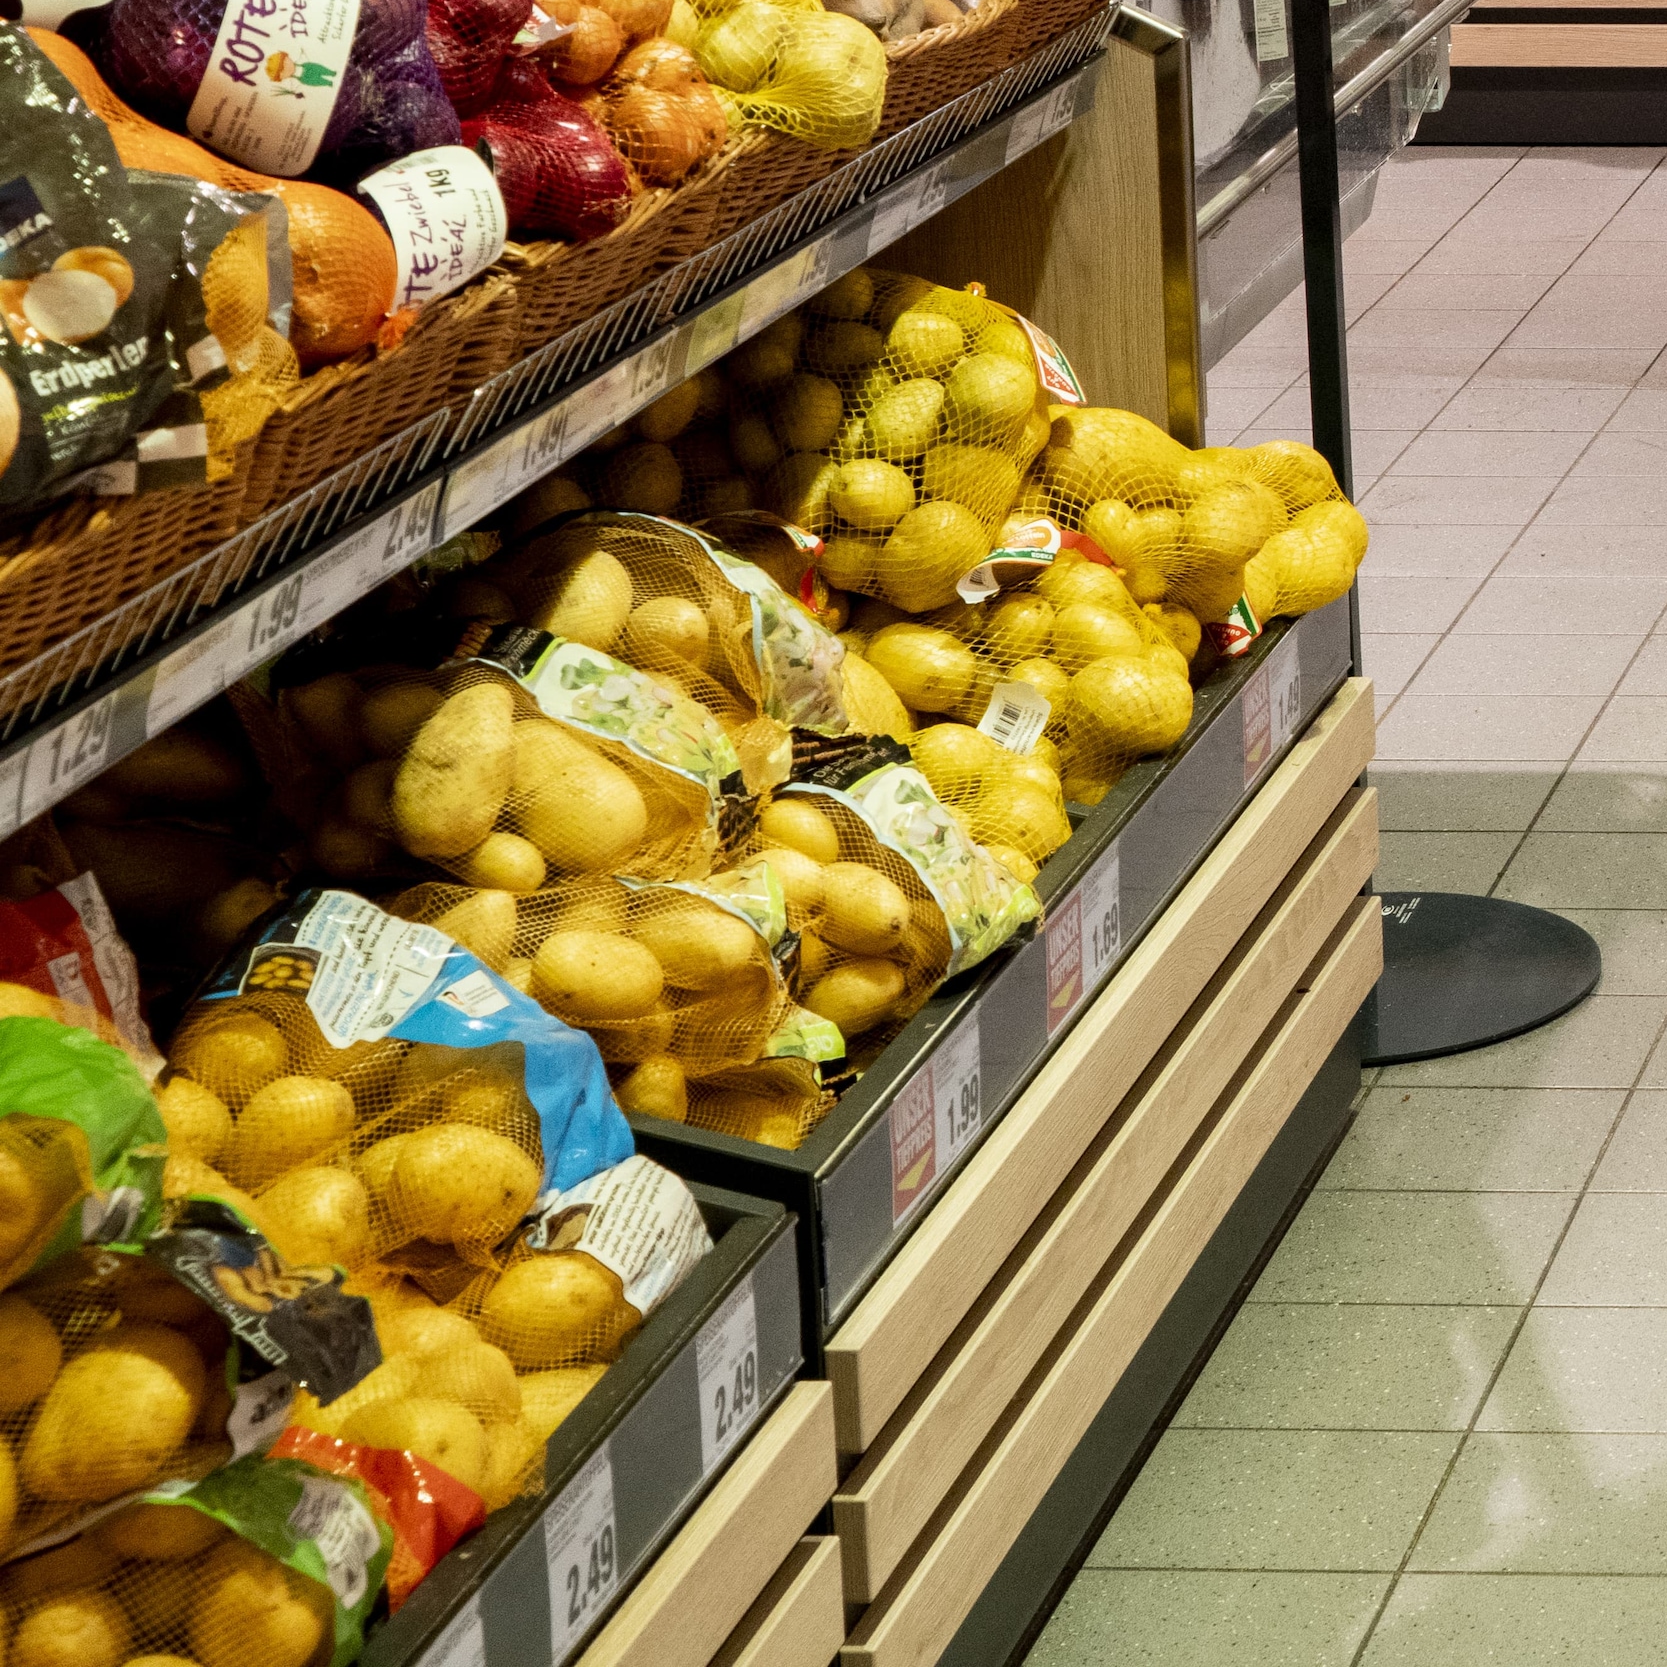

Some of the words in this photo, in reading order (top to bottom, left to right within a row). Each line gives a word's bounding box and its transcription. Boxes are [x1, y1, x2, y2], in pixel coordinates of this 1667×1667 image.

[520, 409, 567, 472] 1.49
[381, 493, 433, 555] 2.49
[245, 576, 303, 646] 1.99
[1277, 676, 1300, 731] 1.49
[49, 699, 111, 784] 1.29
[1091, 902, 1119, 968] 1.69
[947, 1075, 979, 1133] 1.99
[715, 1352, 755, 1441] 2.49
[568, 1525, 613, 1625] 2.49
